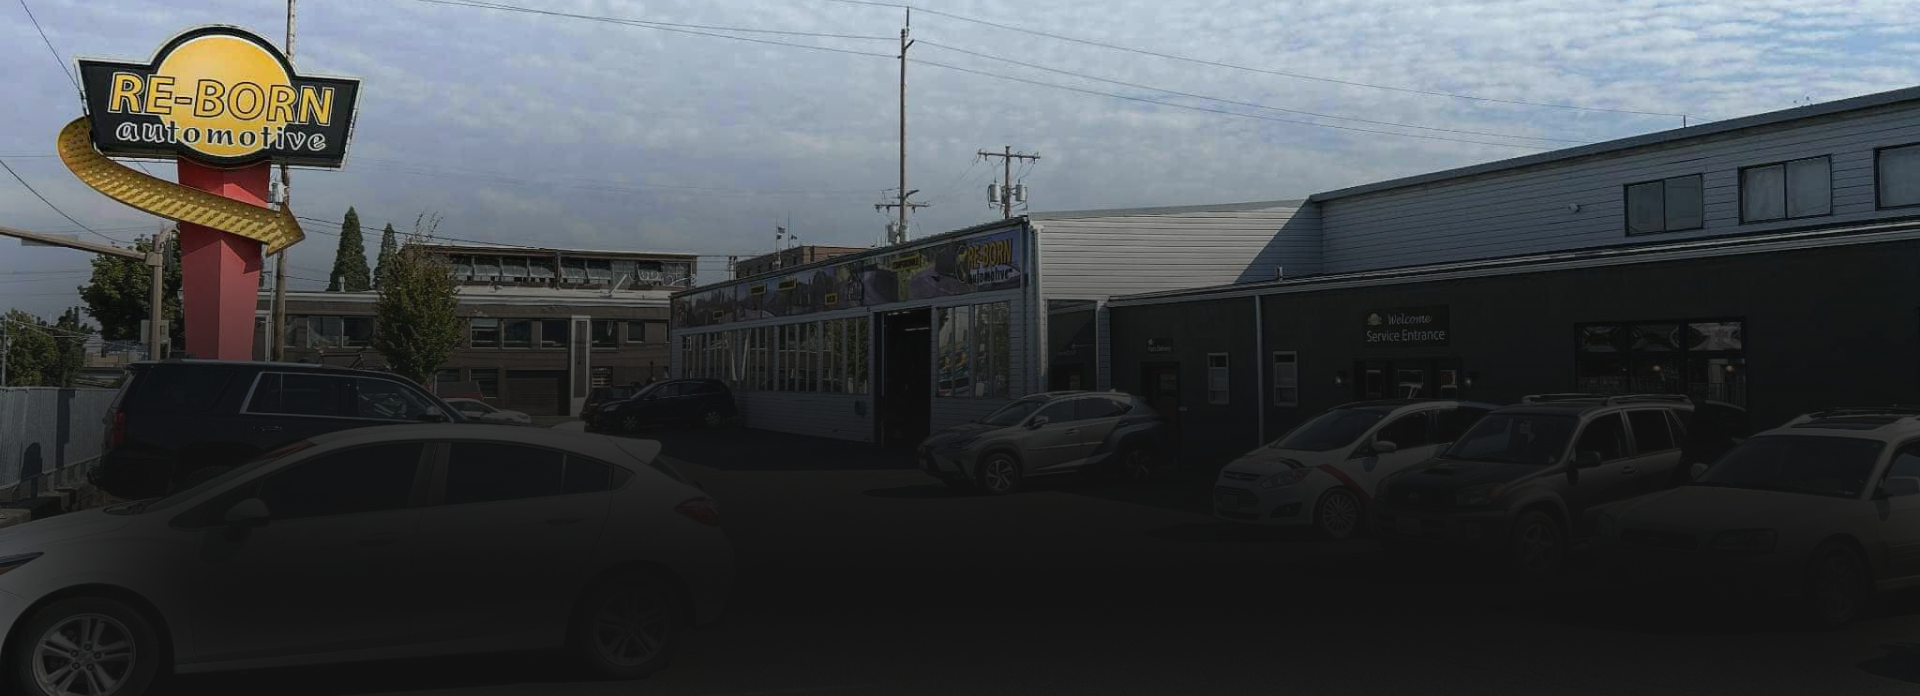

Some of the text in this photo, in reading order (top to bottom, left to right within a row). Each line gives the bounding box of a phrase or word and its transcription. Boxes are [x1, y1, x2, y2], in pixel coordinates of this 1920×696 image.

[107, 71, 337, 126] RE-BORN
[115, 119, 327, 151] automotive
[967, 238, 1013, 269] RE-BORN
[1387, 312, 1433, 325] Welcome
[1366, 329, 1445, 342] Service Entrance
